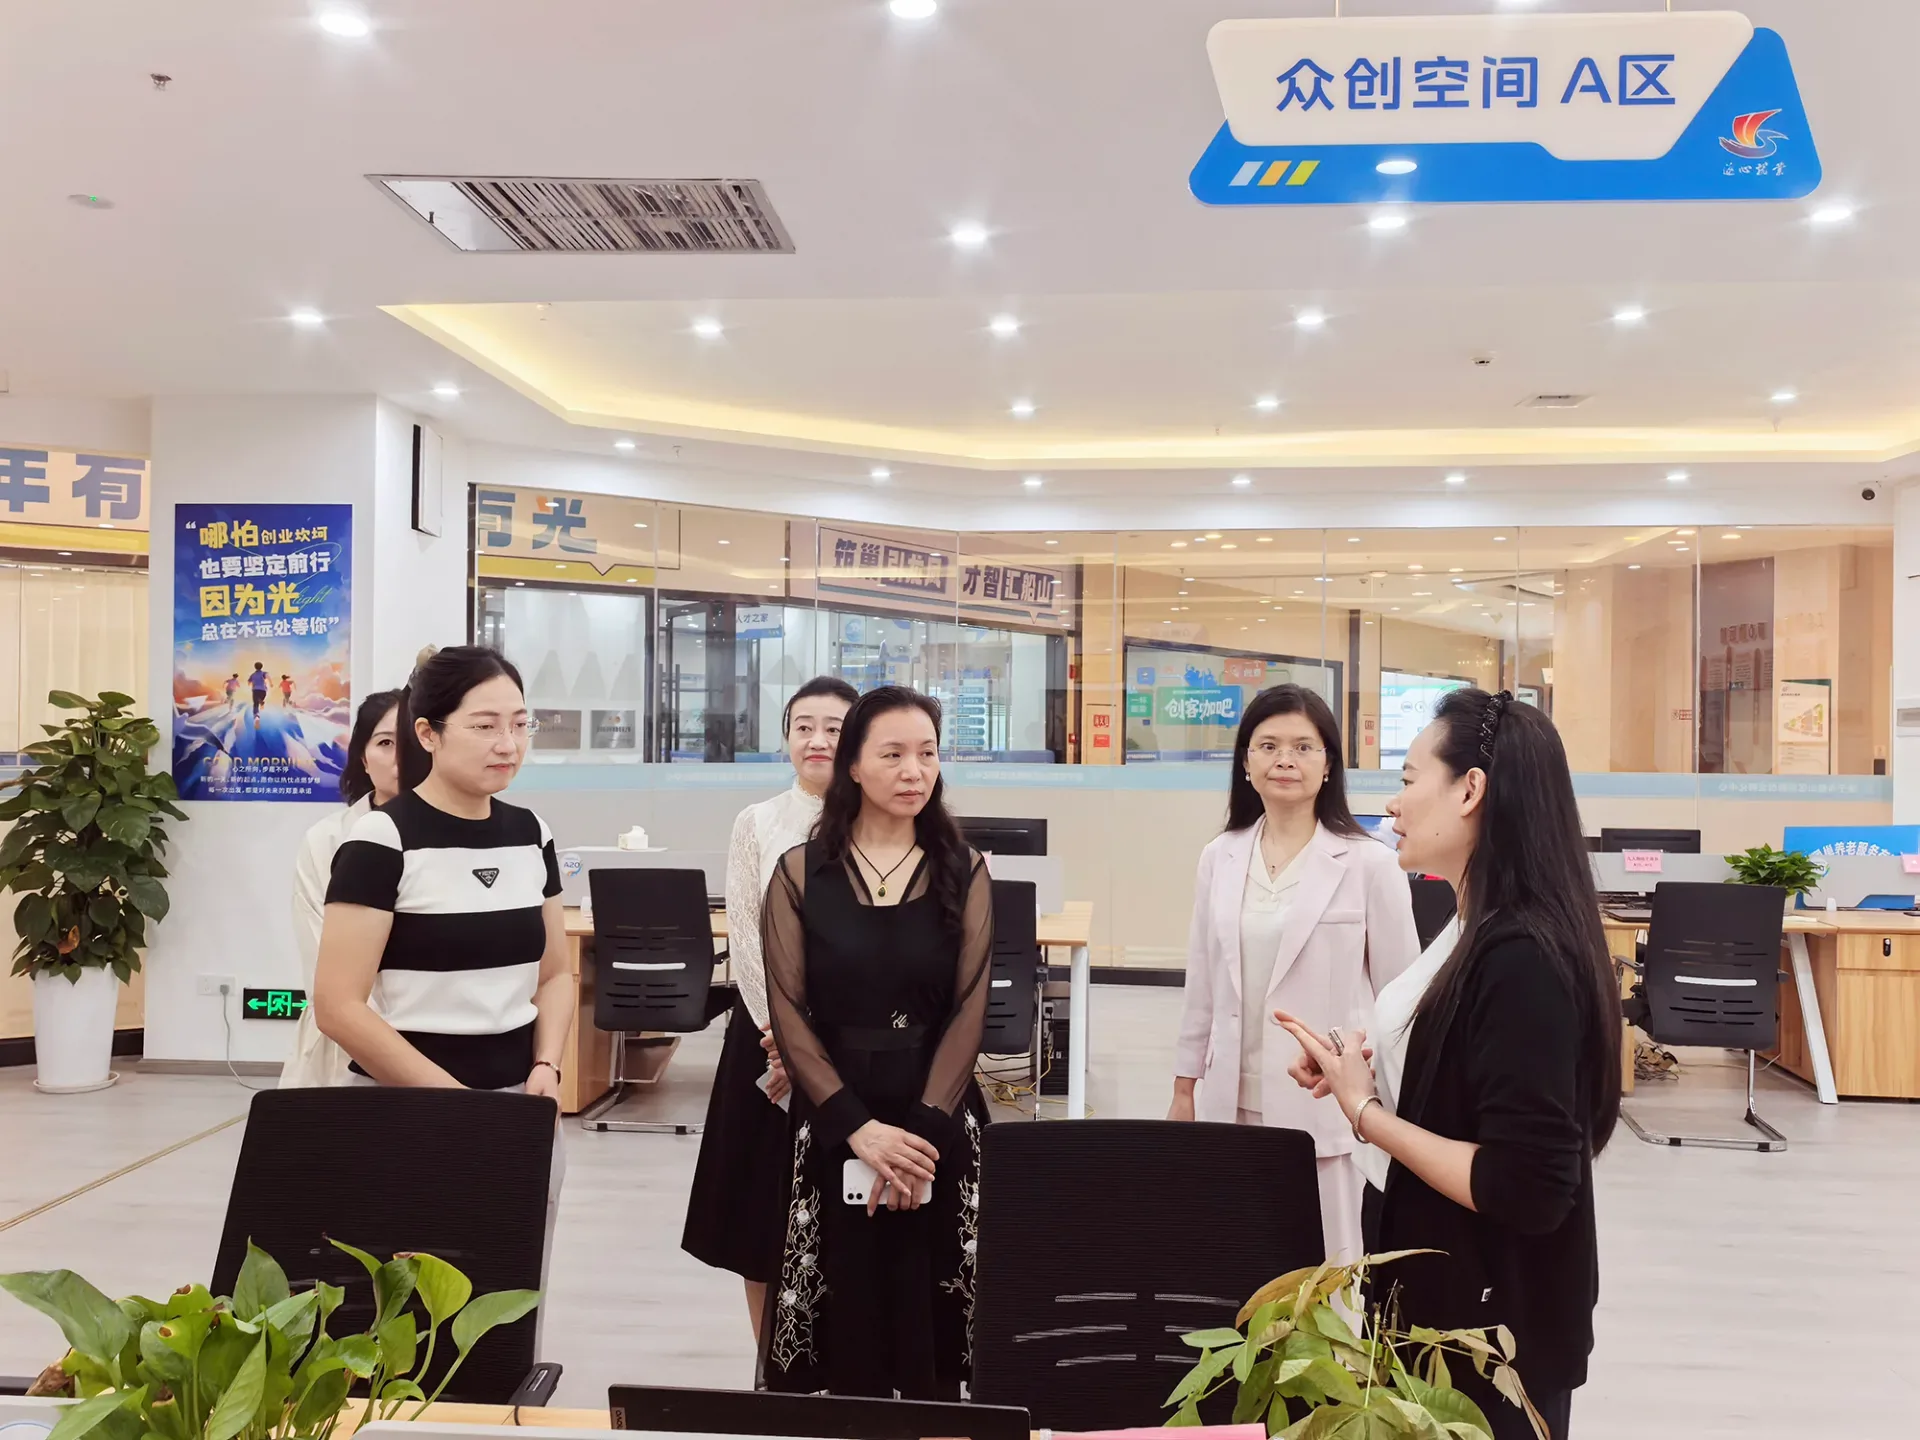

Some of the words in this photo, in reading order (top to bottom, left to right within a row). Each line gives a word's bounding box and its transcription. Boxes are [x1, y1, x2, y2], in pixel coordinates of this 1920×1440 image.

[1276, 55, 1538, 111] 众创空间
[1560, 54, 1676, 104] A区
[199, 551, 331, 579] 也要坚定前行
[199, 581, 300, 618] 因为光
[962, 564, 1054, 608] 才智汇船山
[1164, 697, 1236, 720] 创客咖吧
